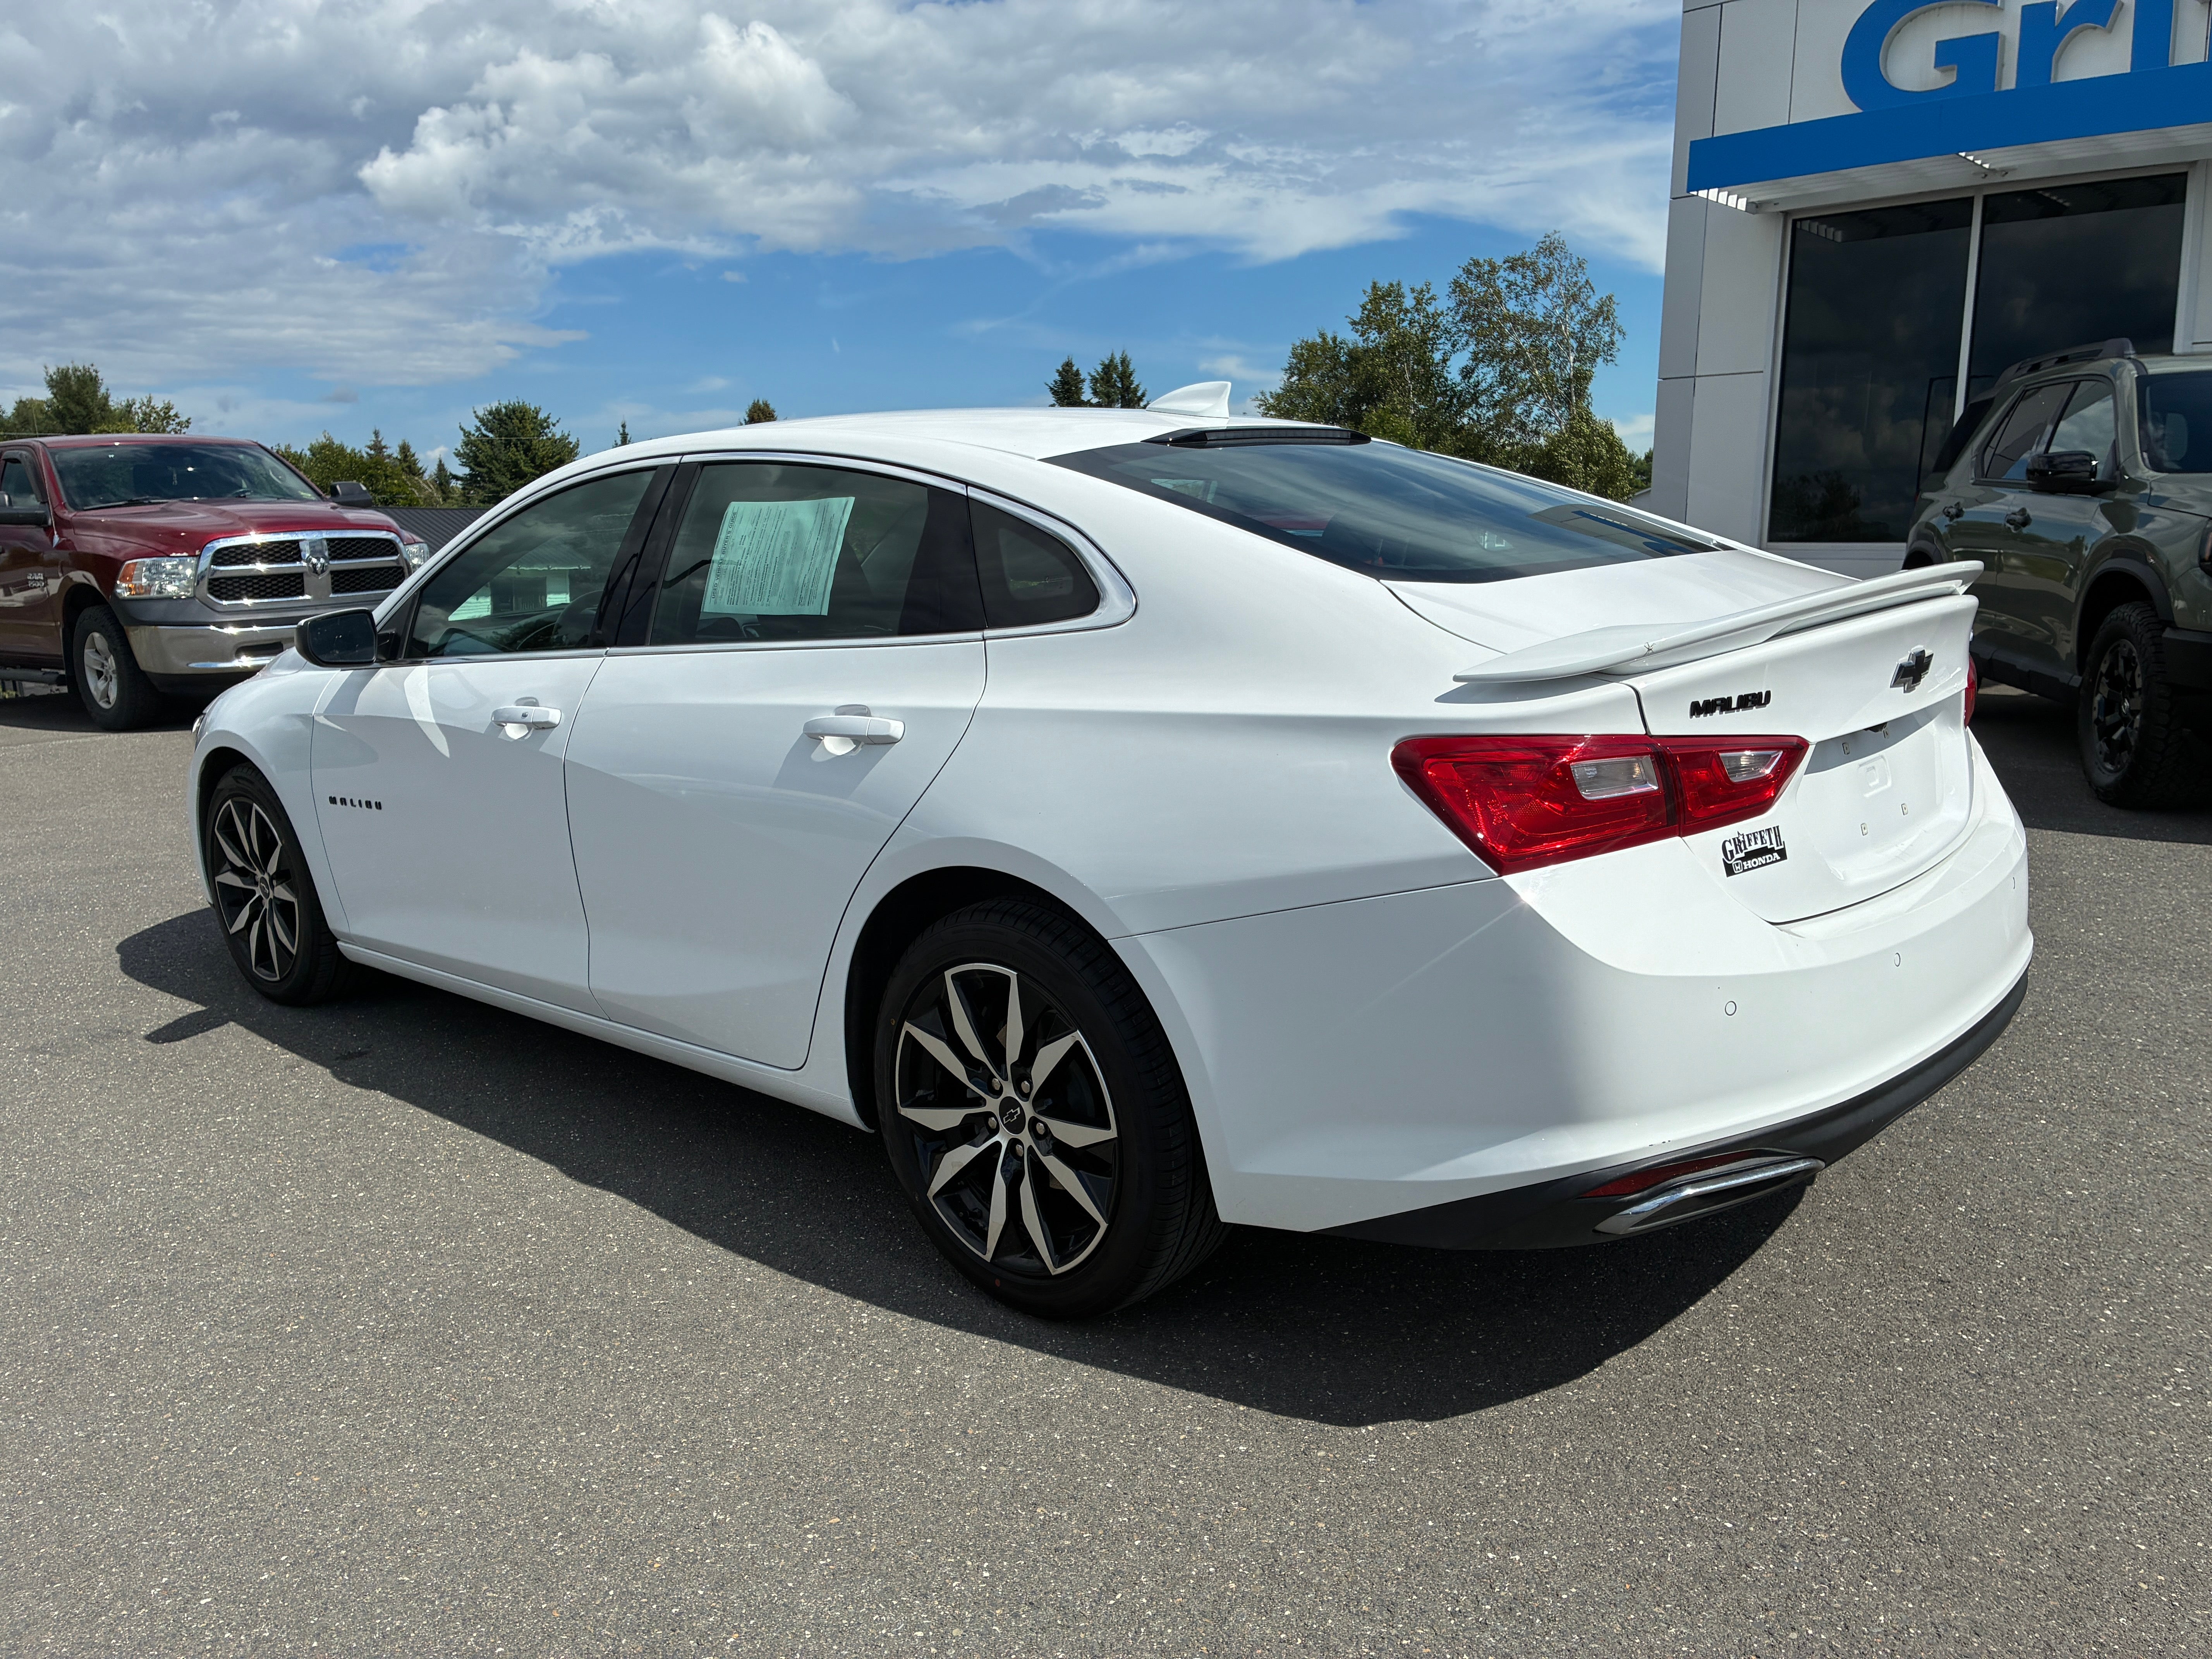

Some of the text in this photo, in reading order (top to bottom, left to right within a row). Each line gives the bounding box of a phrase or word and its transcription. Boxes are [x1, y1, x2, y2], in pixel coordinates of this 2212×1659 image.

[1690, 690, 1771, 718] MALIBU
[329, 796, 382, 810] MALIBU
[1721, 825, 1783, 861] GRIFFETH
[1743, 852, 1781, 870] HONDA
